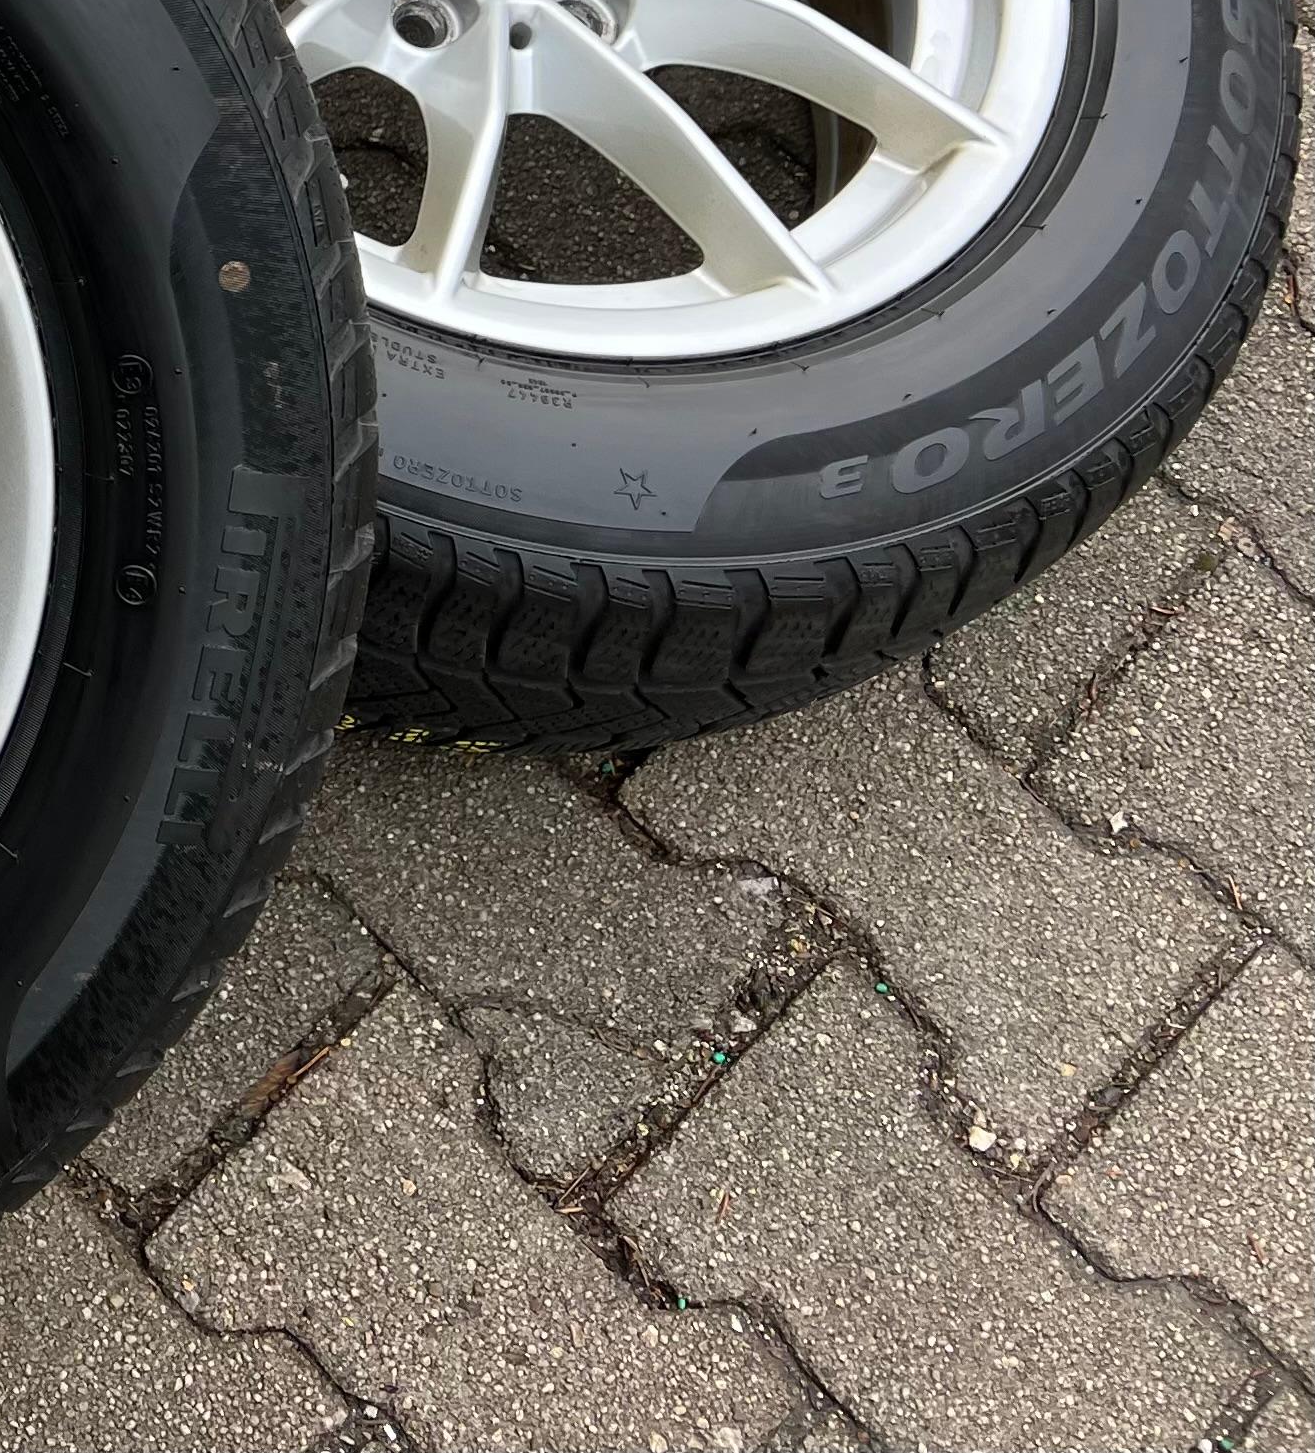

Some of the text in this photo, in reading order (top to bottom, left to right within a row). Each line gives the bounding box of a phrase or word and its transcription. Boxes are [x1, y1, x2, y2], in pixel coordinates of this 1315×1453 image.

[385, 350, 445, 379] EXTRA
[393, 454, 523, 504] SOTTOZERO
[818, 455, 869, 499] 3
[155, 465, 308, 851] PIRELLI
